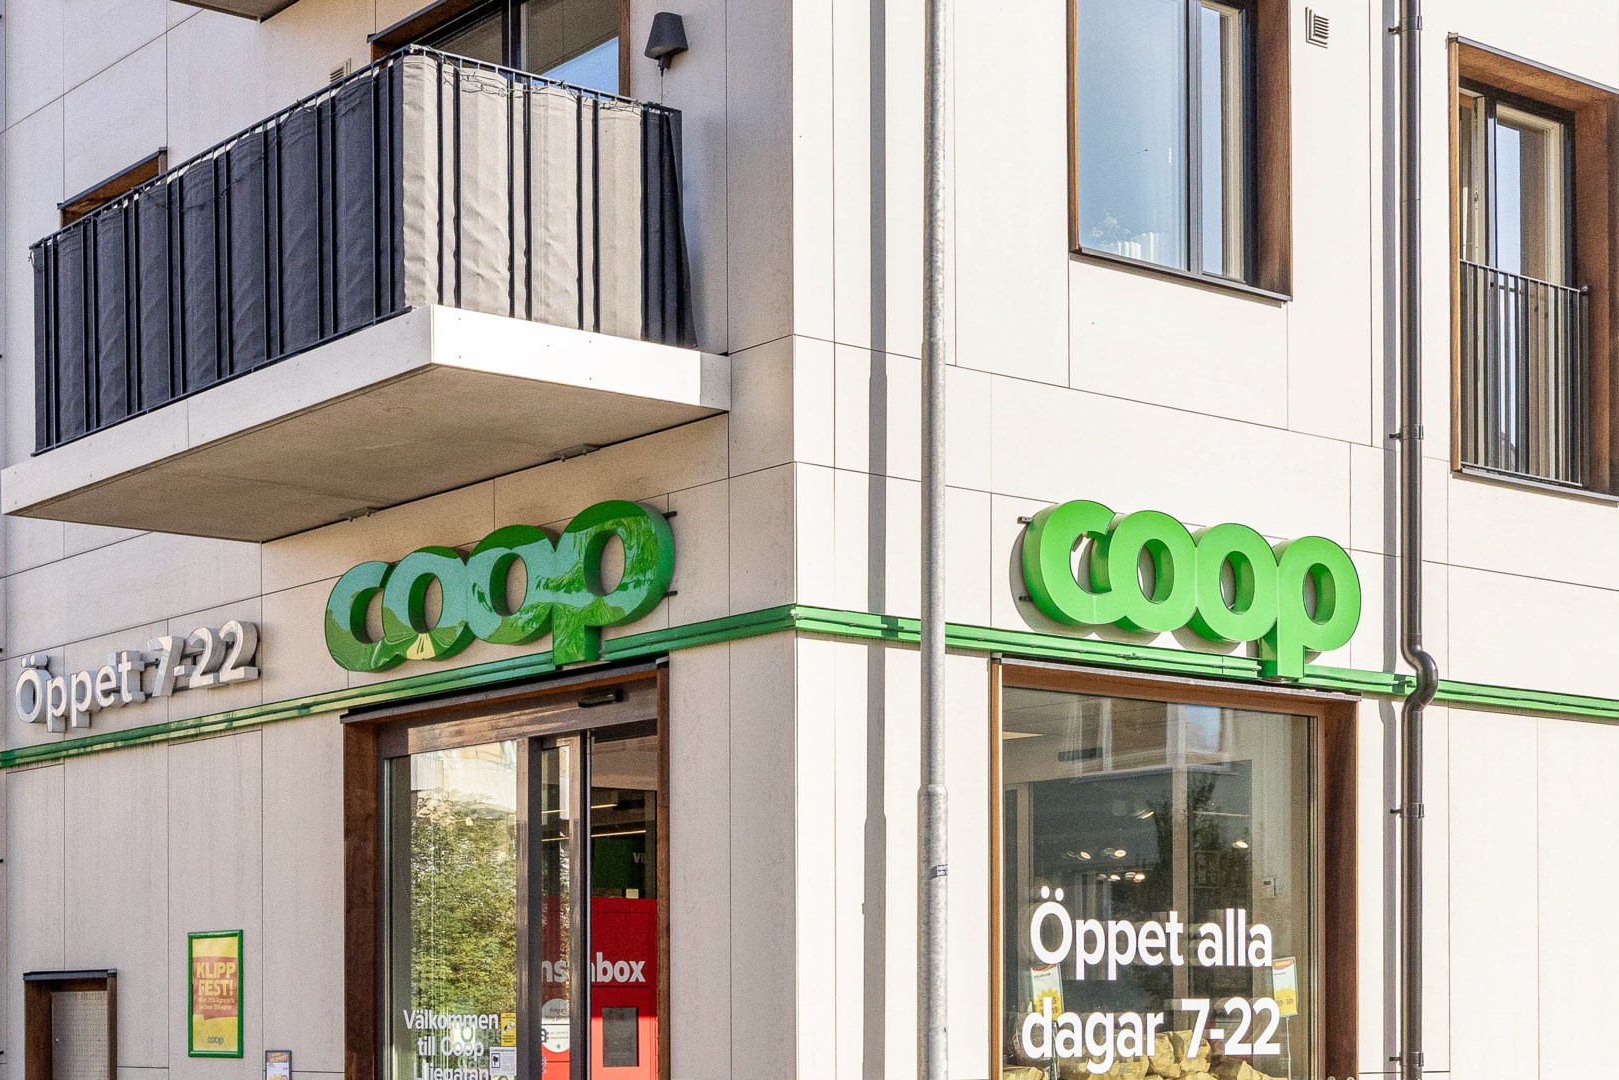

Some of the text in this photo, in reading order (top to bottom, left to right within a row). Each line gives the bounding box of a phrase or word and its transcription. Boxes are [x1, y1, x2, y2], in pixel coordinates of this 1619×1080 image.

[325, 500, 674, 672] coop
[1022, 499, 1362, 679] coop
[16, 620, 260, 733] Öppet 7-22
[196, 961, 237, 979] KLIPP
[1030, 885, 1273, 982] Öppet alla
[198, 979, 234, 996] FEST!
[403, 1009, 499, 1030] Välkommen
[417, 1036, 484, 1062] till Coop
[1021, 996, 1281, 1075] dagar 7-22
